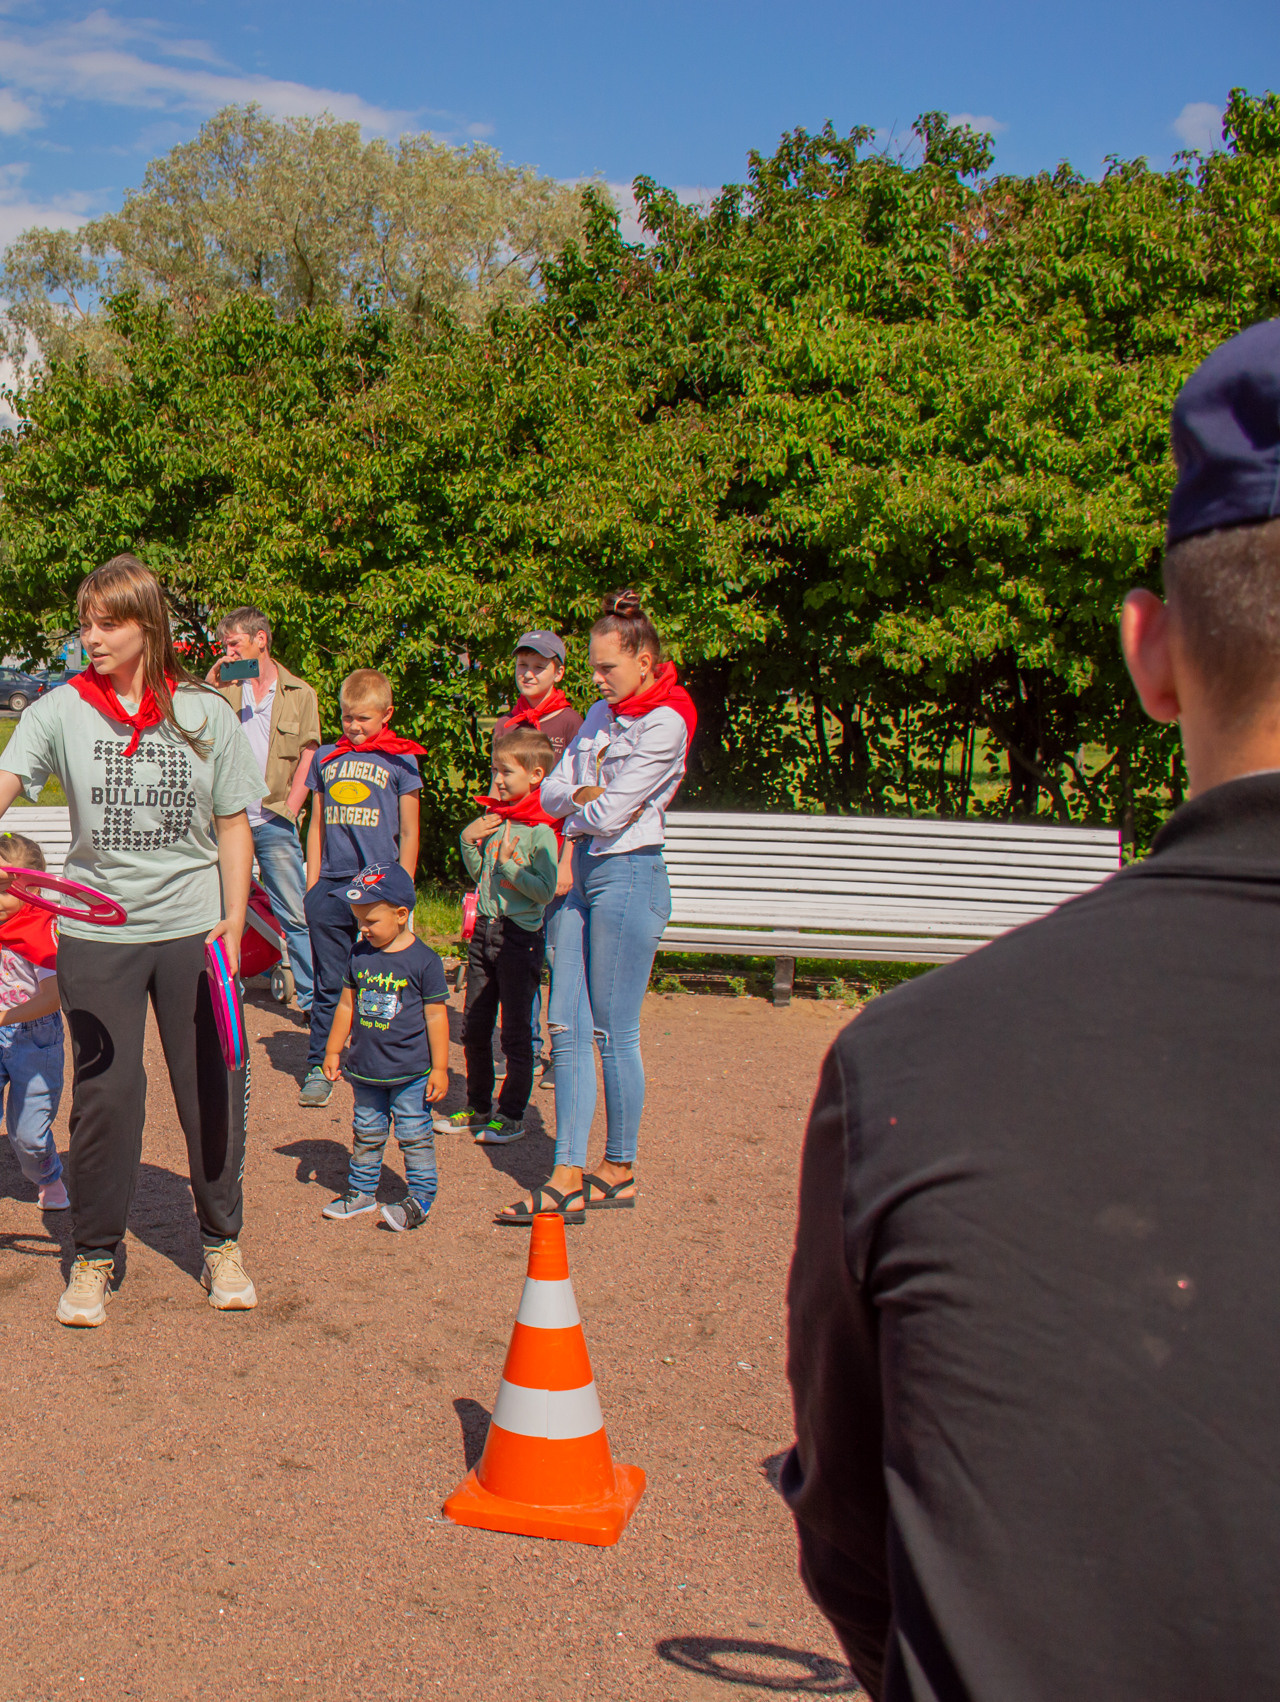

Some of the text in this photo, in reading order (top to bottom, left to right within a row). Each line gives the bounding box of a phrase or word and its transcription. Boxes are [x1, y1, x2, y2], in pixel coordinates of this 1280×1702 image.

[338, 760, 390, 790] ANGELES
[91, 786, 197, 808] BULLDOGS
[324, 805, 380, 828] HARGERS
